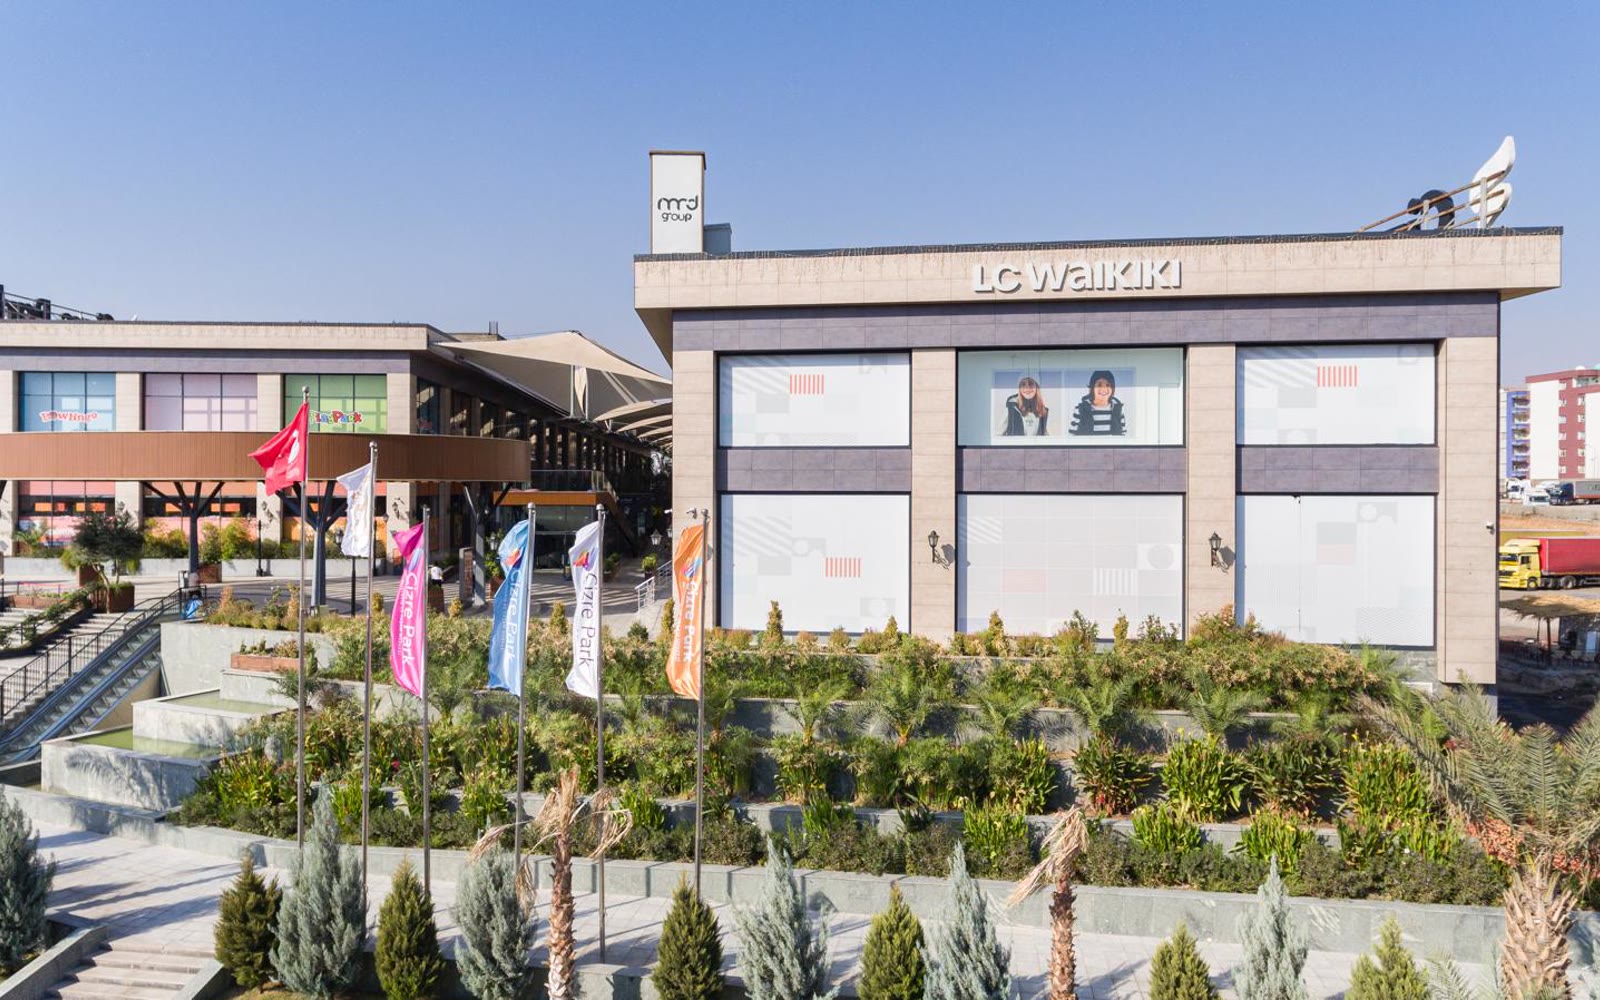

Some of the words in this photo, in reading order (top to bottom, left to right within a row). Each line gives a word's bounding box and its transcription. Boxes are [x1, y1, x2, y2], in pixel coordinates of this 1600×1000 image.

[661, 212, 692, 222] group
[972, 264, 1021, 293] LC
[404, 572, 418, 618] Cizre
[509, 569, 522, 616] Cizre
[581, 573, 598, 619] Cizre
[685, 580, 698, 620] Cizre
[402, 625, 416, 666] Park
[505, 622, 518, 664] Park
[578, 626, 596, 667] Park
[683, 625, 696, 663] Park
